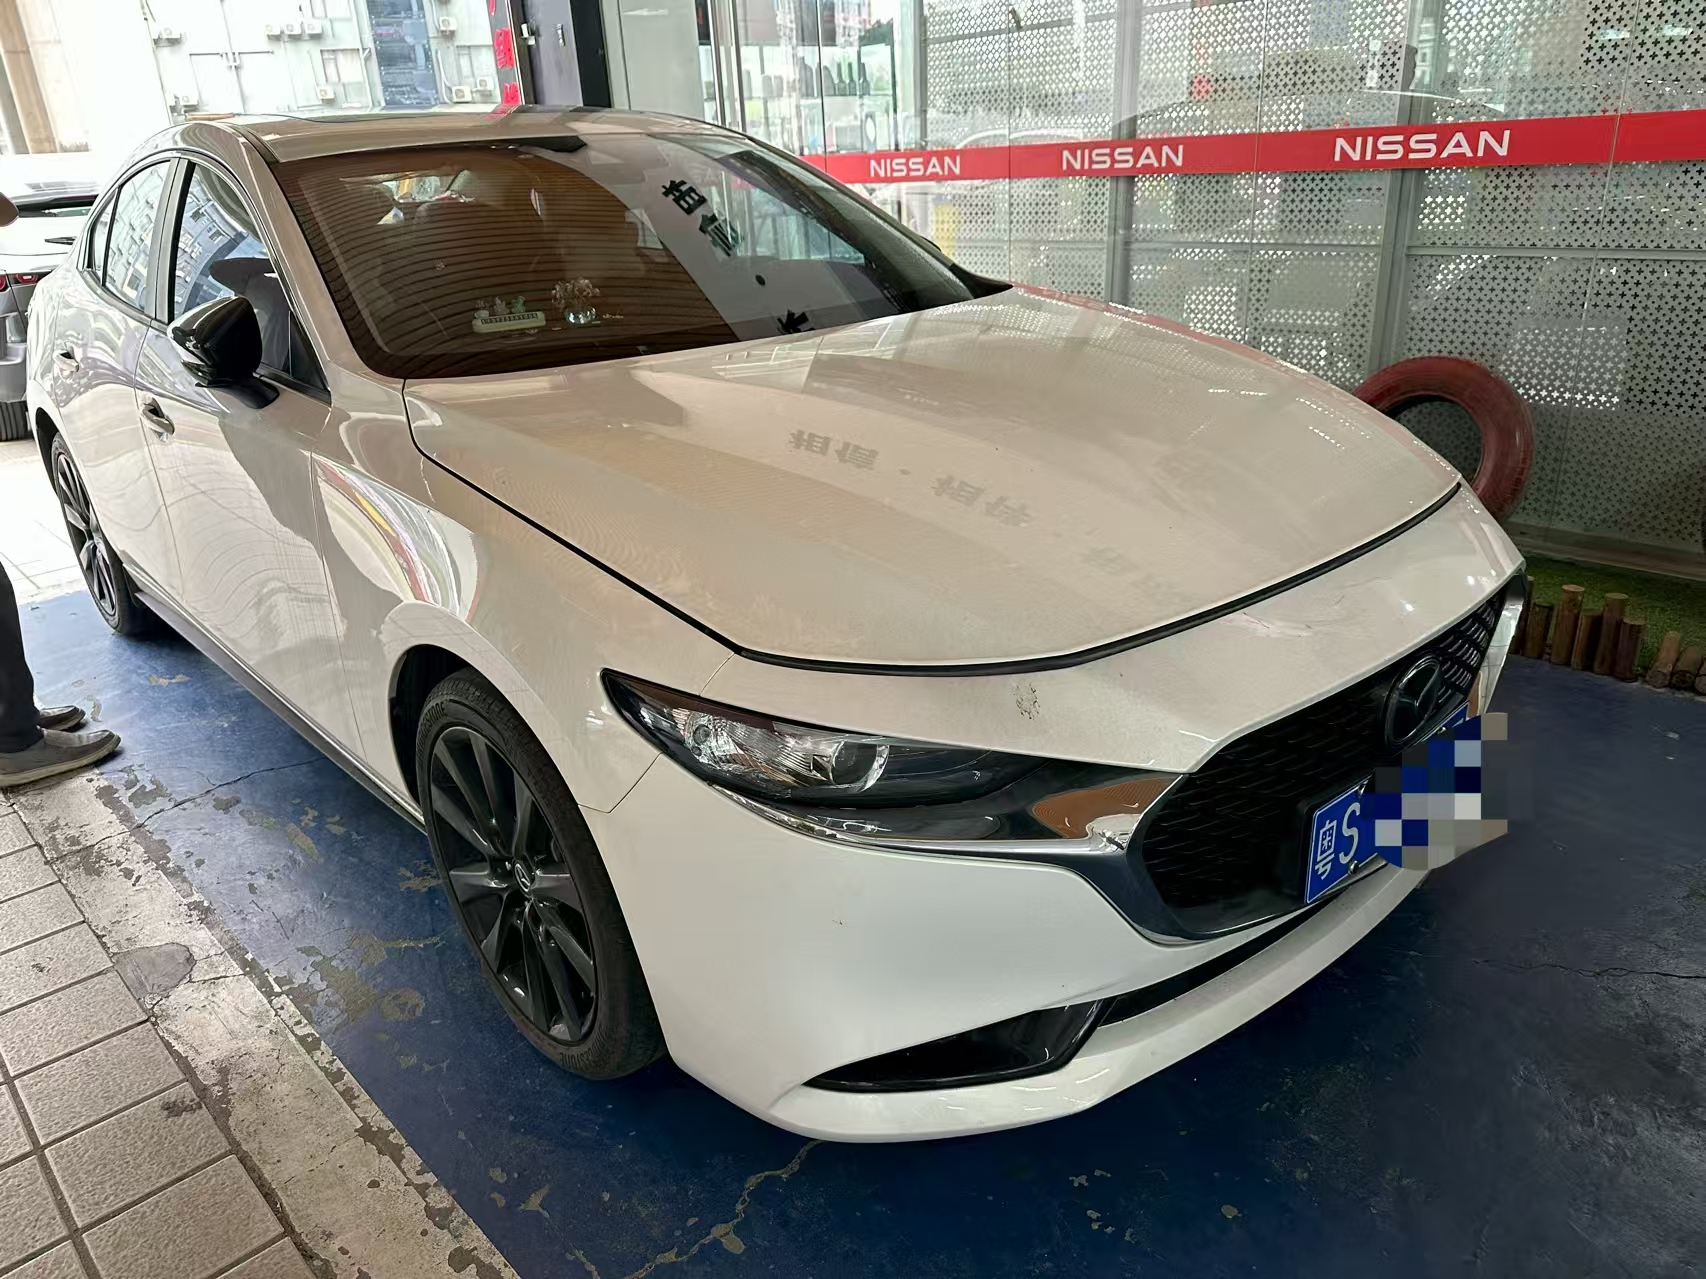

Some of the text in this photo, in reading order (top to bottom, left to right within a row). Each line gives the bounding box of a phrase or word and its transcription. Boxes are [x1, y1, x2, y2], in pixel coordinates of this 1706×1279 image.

[1062, 144, 1184, 171] NISSAN
[1334, 129, 1511, 162] NISSAN
[869, 155, 961, 177] NISSAN
[1315, 802, 1361, 881] 粤S
